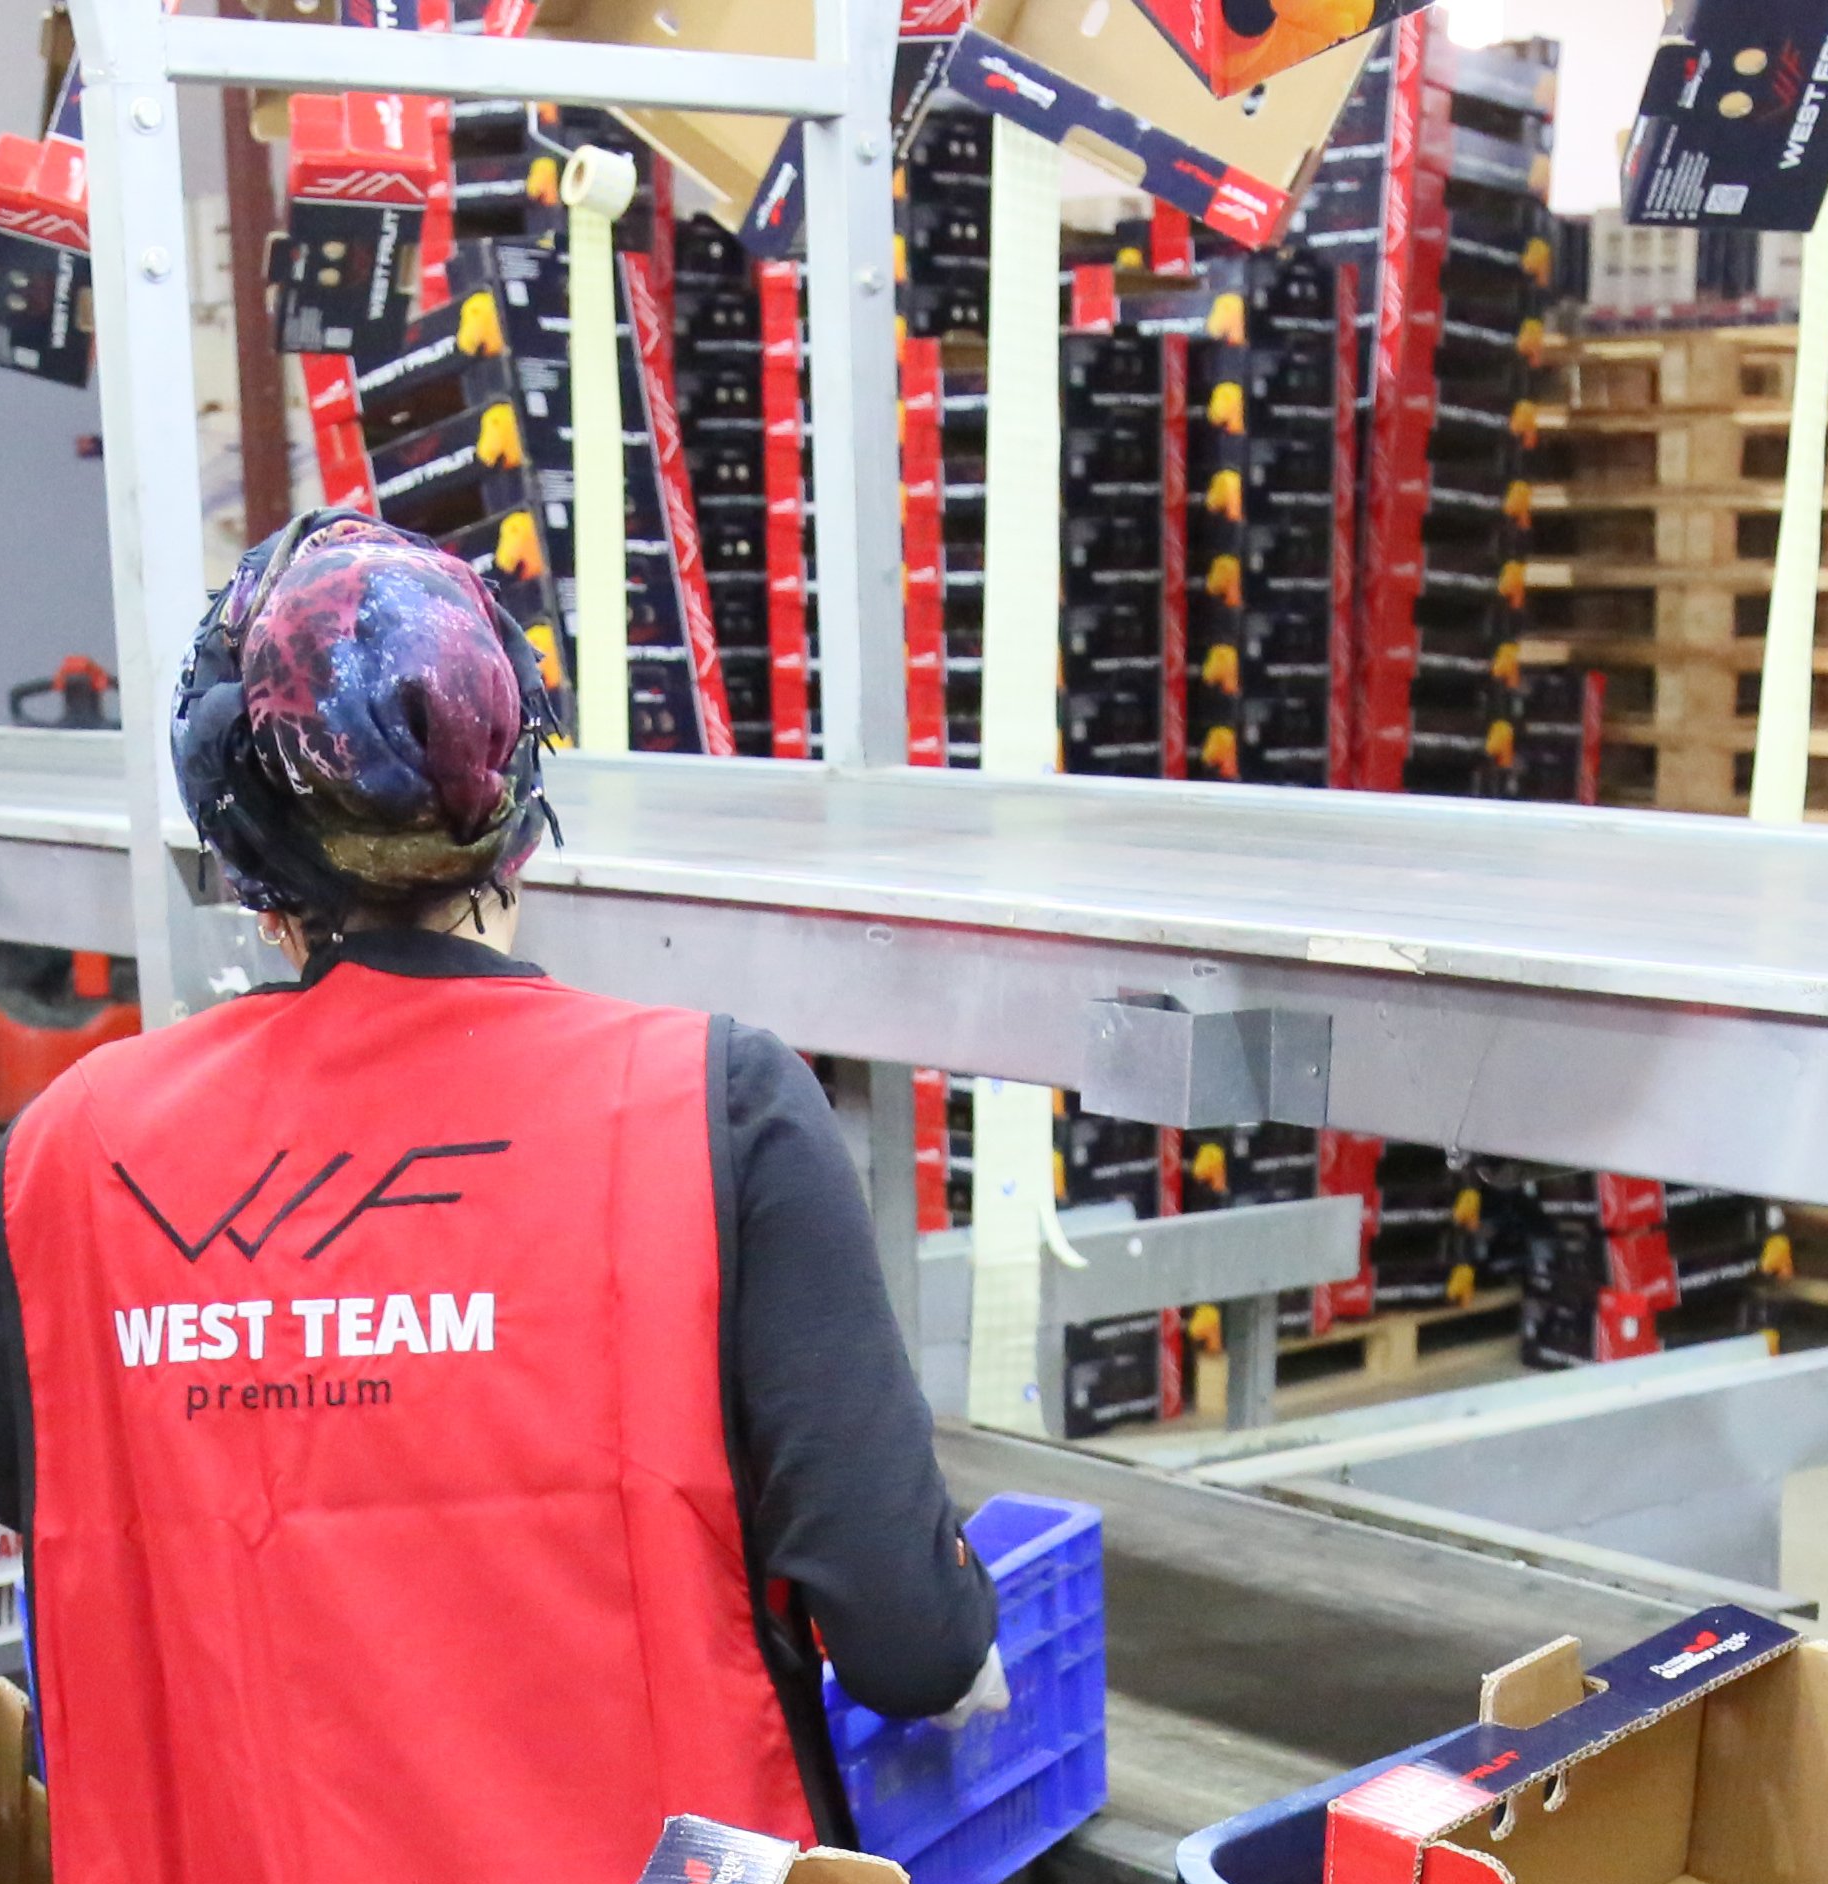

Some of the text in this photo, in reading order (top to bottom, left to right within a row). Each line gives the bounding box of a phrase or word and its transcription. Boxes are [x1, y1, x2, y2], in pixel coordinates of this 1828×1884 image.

[1779, 83, 1826, 170] WEST
[114, 1293, 495, 1369] WEST TEAM
[186, 1371, 393, 1420] premium
